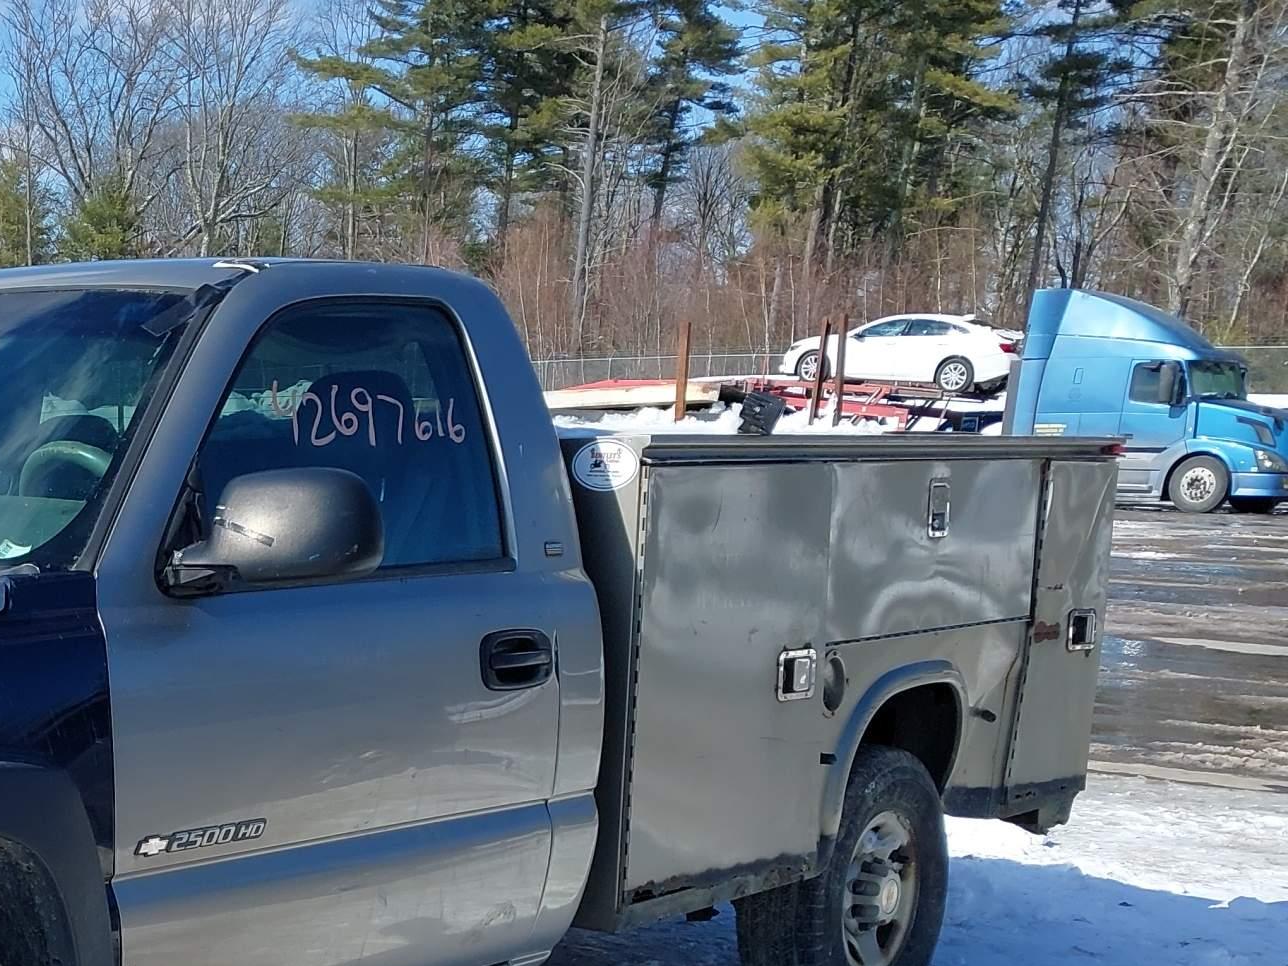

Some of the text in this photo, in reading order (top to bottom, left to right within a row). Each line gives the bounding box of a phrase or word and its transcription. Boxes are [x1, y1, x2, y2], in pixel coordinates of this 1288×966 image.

[270, 379, 466, 446] 42697616
[170, 822, 264, 851] 2500 HD
